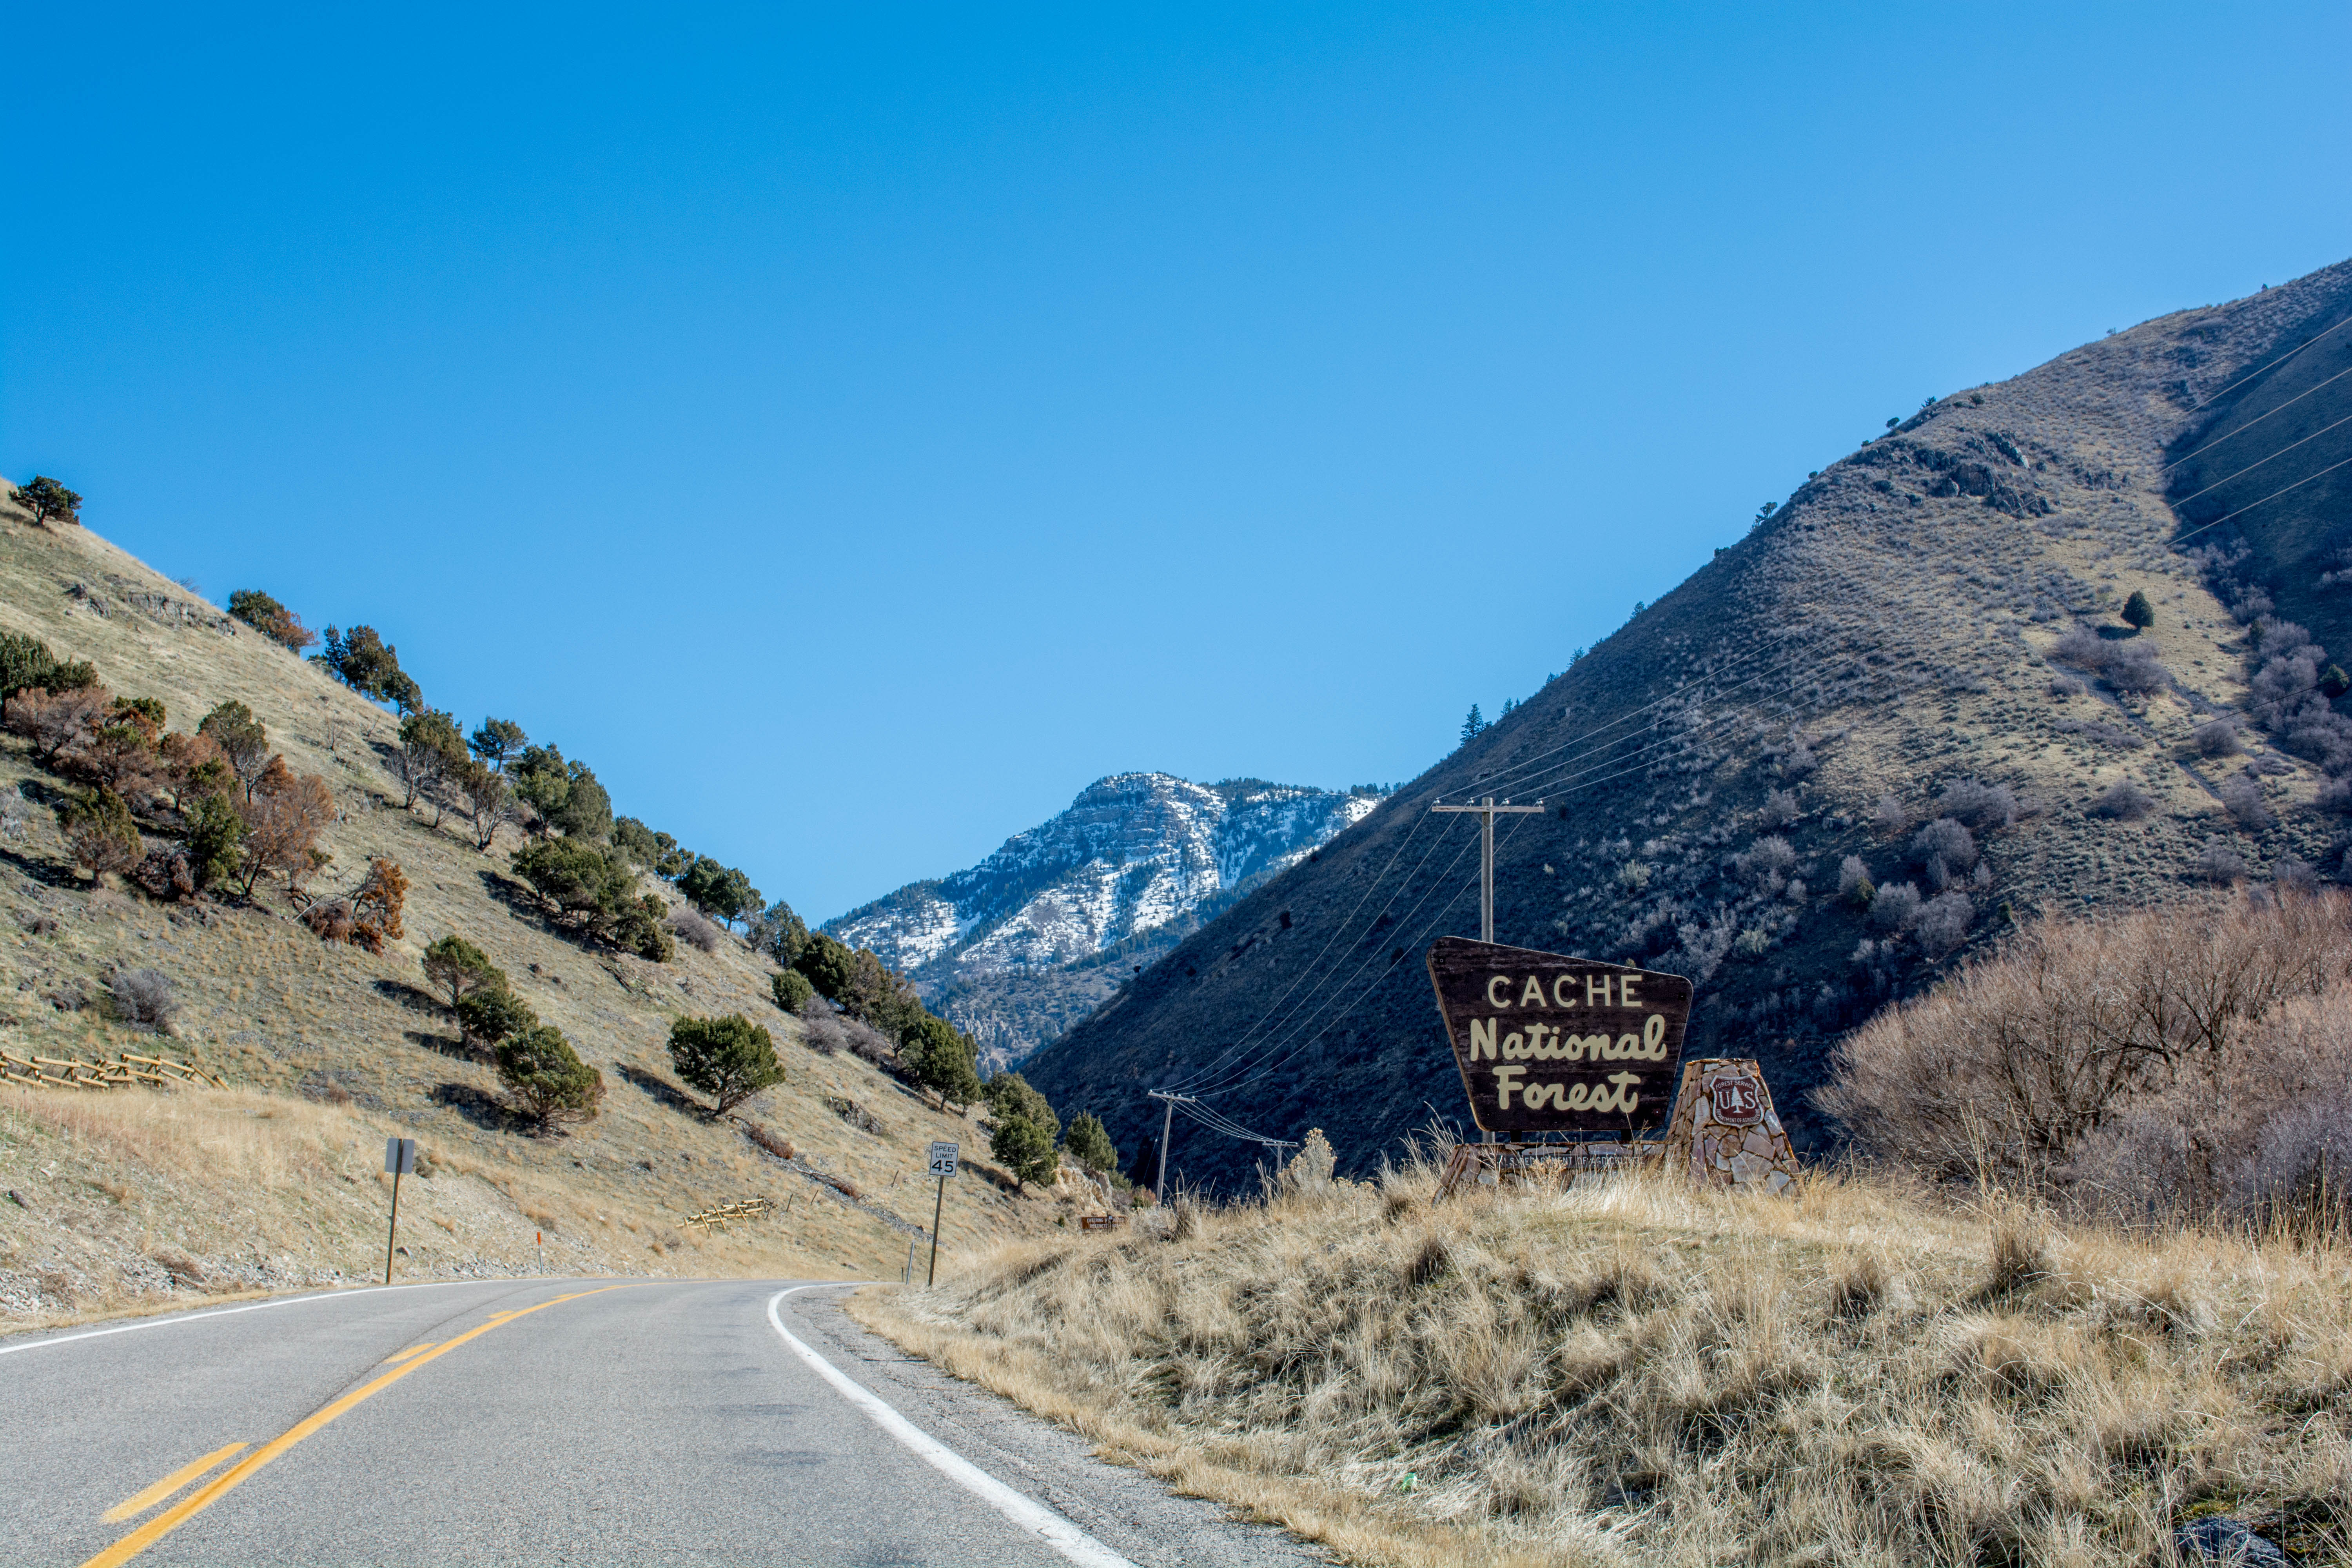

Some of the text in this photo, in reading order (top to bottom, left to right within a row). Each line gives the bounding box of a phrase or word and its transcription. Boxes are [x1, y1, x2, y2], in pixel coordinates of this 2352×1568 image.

[1488, 975, 1643, 1008] CACHE
[1470, 1014, 1668, 1062] National
[1492, 1065, 1641, 1113] Forest
[1715, 1080, 1754, 1090] FOREST SERVICE
[1718, 1091, 1756, 1109] U S
[1716, 1109, 1737, 1123] DEPARTMENT
[1742, 1108, 1760, 1123] AGRICULTURE
[931, 1160, 954, 1173] 45
[1519, 1157, 1572, 1165] DEPRENT
